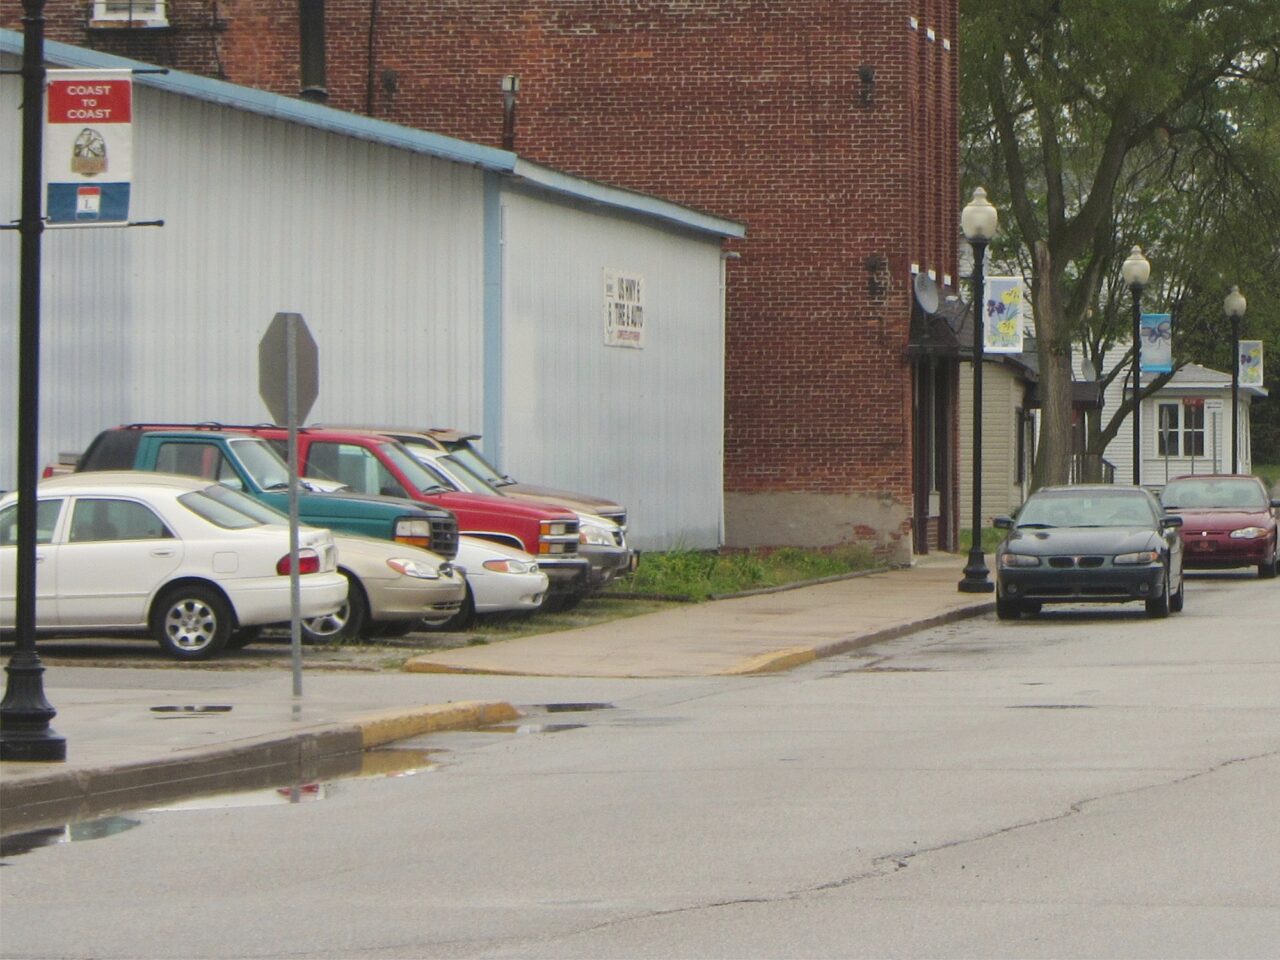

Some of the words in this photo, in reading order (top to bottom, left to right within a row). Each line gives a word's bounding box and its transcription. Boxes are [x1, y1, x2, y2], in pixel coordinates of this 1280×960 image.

[67, 86, 111, 95] COAST
[82, 99, 97, 107] TO
[67, 109, 112, 119] COAST
